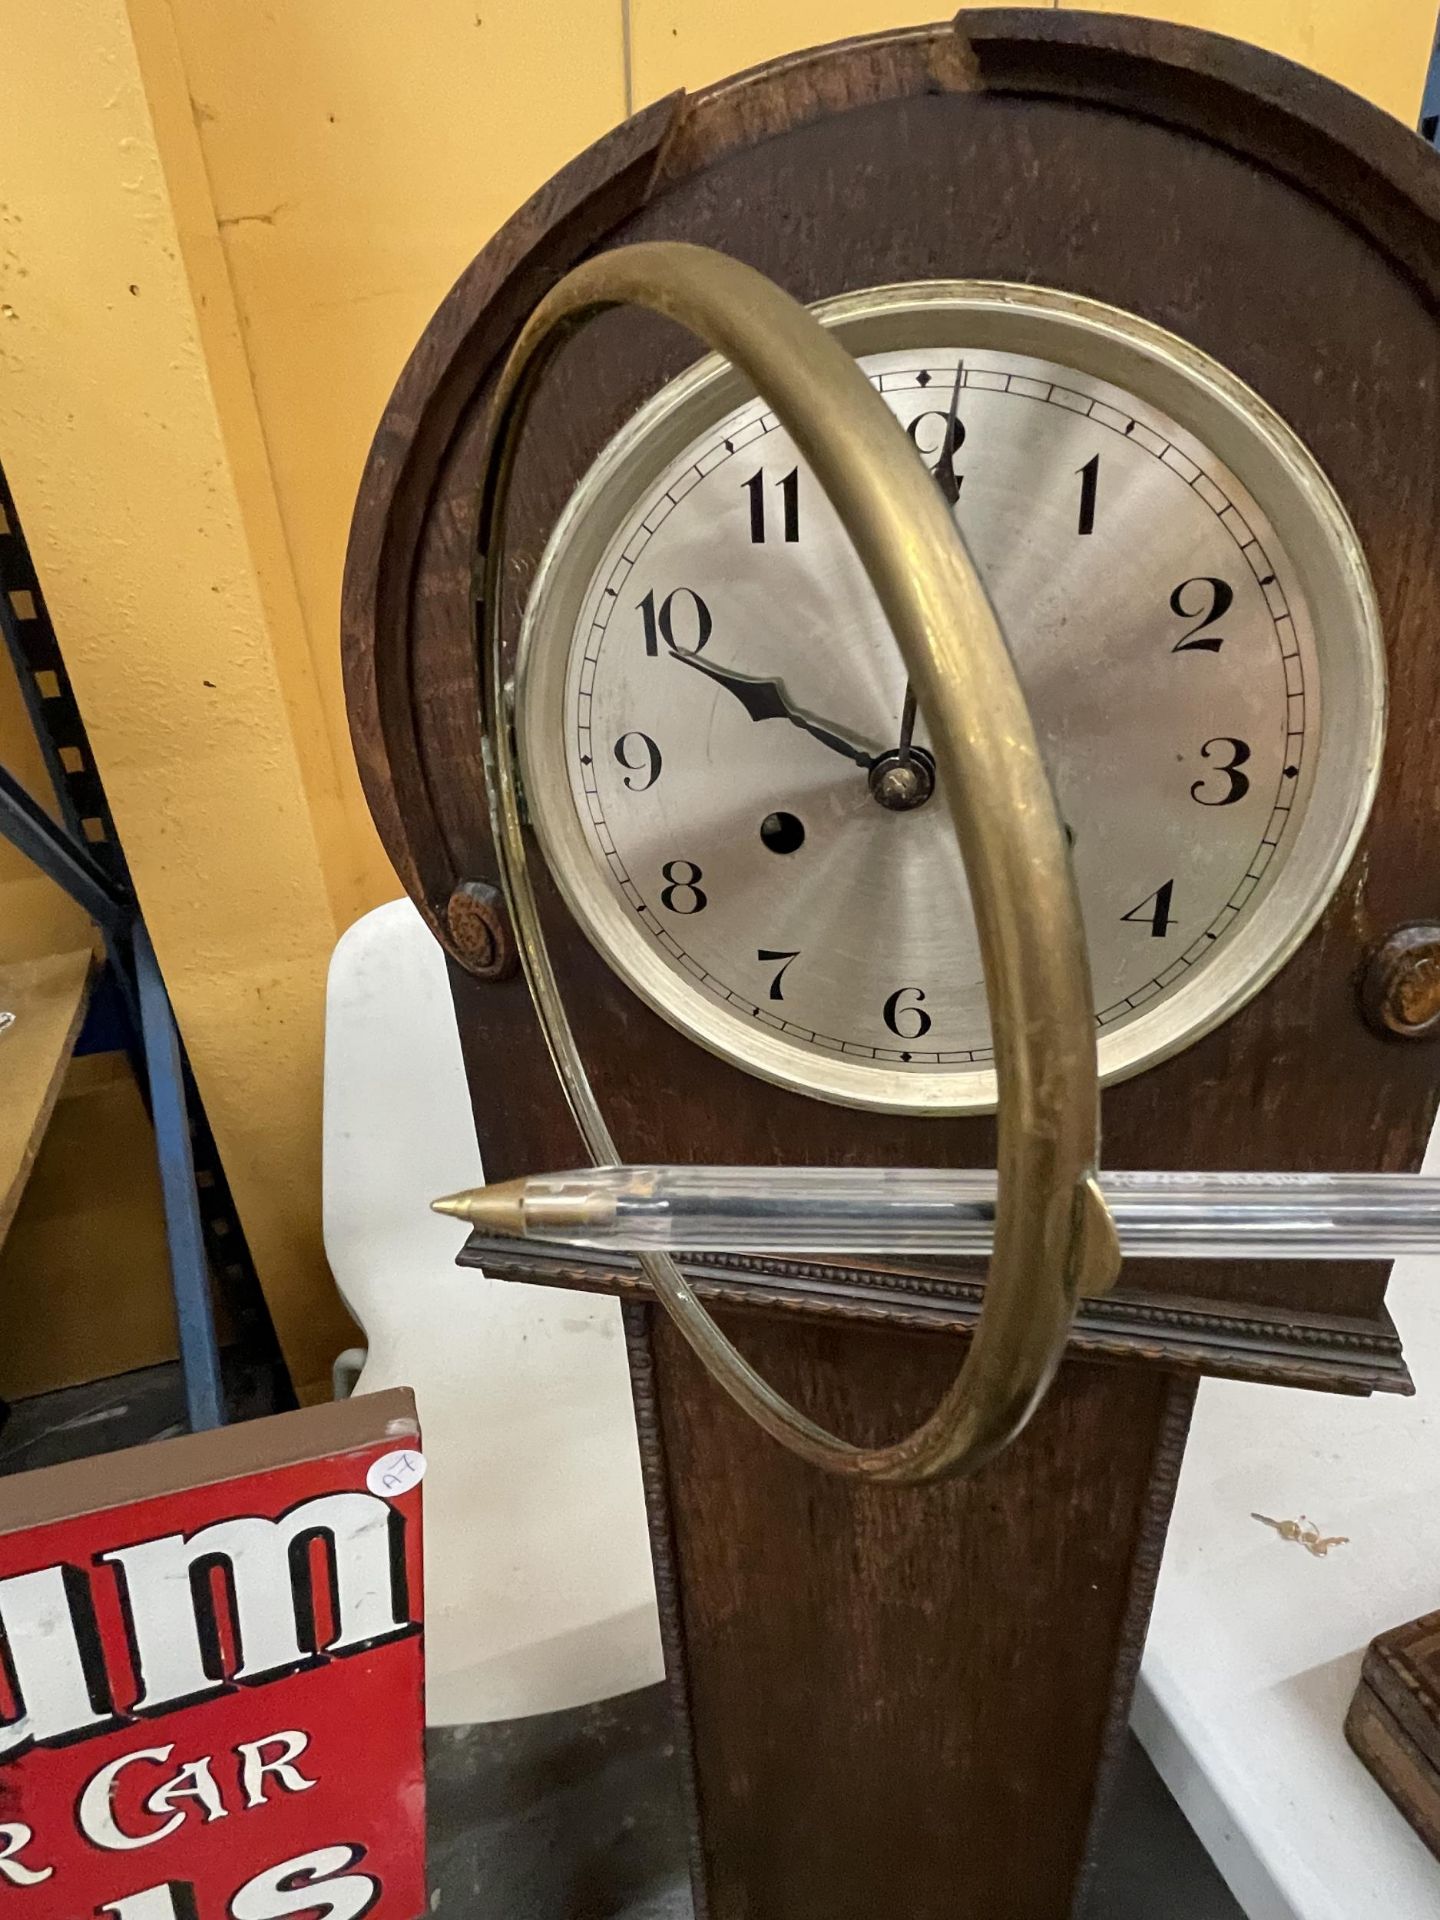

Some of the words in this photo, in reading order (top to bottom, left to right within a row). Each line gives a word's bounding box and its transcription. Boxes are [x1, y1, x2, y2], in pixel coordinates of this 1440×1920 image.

[740, 466, 800, 544] 11
[1074, 452, 1099, 535] 1
[634, 586, 713, 657] 10
[1169, 576, 1234, 653] 2
[613, 731, 662, 792] 9
[1190, 736, 1251, 806] 3
[660, 860, 708, 915] 8
[1119, 878, 1179, 938] 4
[757, 949, 801, 1000] 7
[882, 987, 932, 1039] 6
[78, 1729, 318, 1850] CAR
